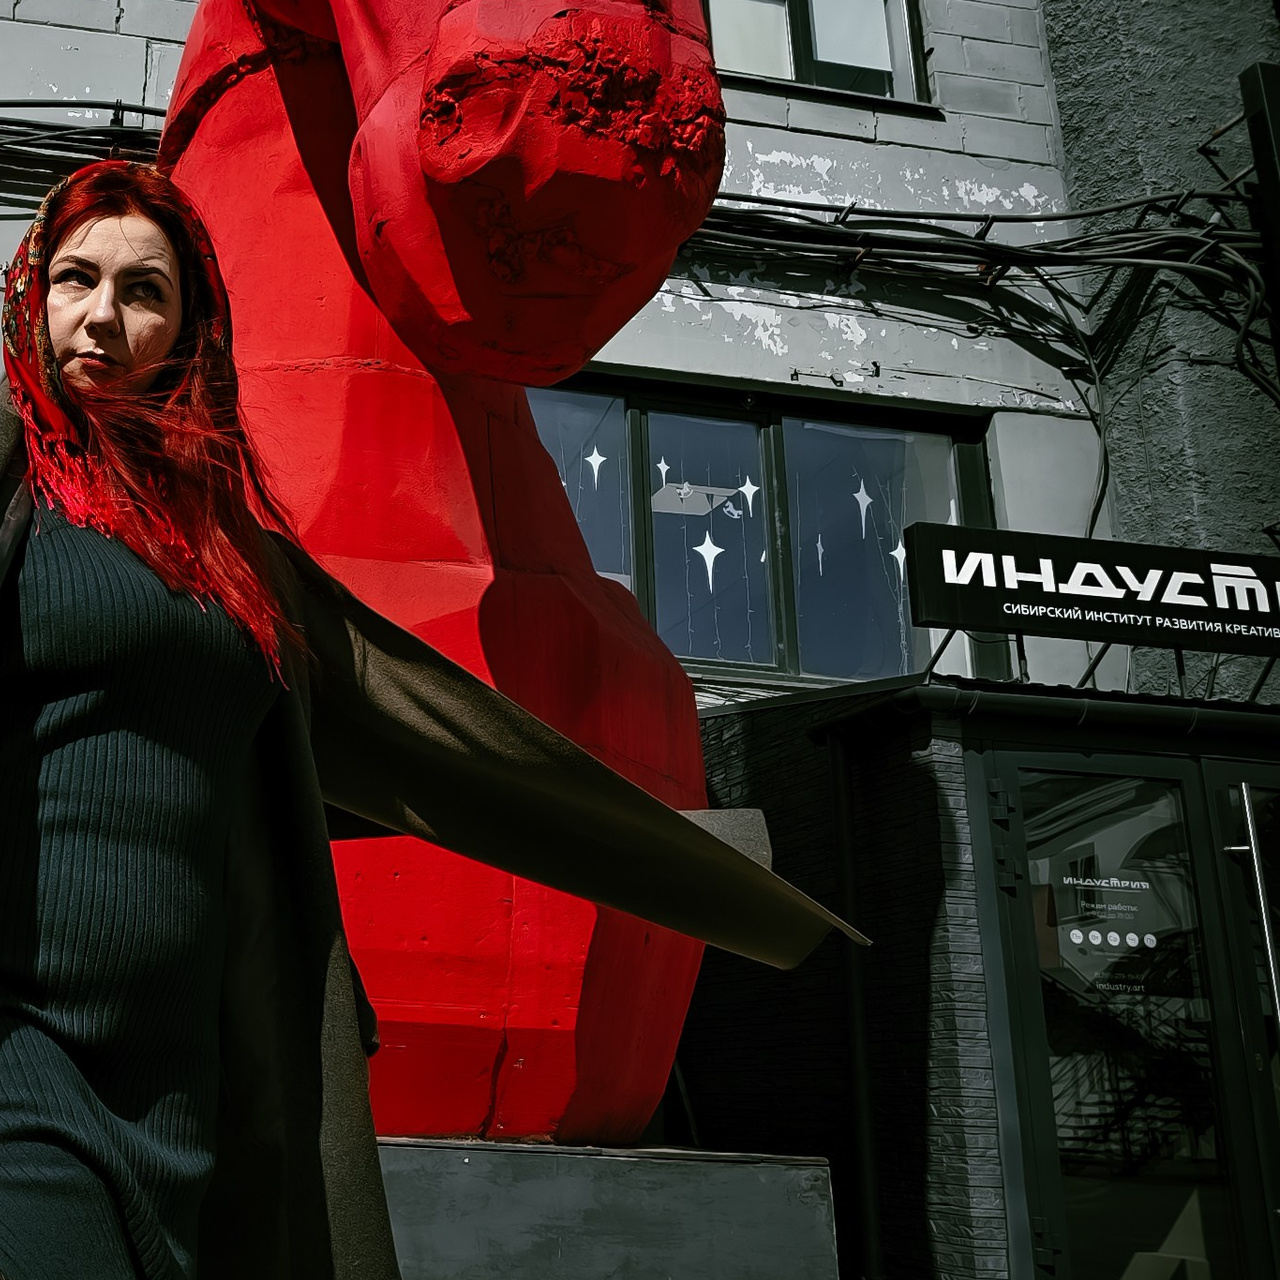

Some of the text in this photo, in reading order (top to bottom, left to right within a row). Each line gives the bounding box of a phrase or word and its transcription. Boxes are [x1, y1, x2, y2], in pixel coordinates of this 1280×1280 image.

[942, 549, 1280, 613] ИНДУСТ
[1003, 603, 1082, 620] СИБИРСКИЙ
[1085, 609, 1152, 626] ИНСТИТУТ
[1155, 616, 1223, 633] РАЗВИТИЯ
[1095, 981, 1145, 993] industry.art
